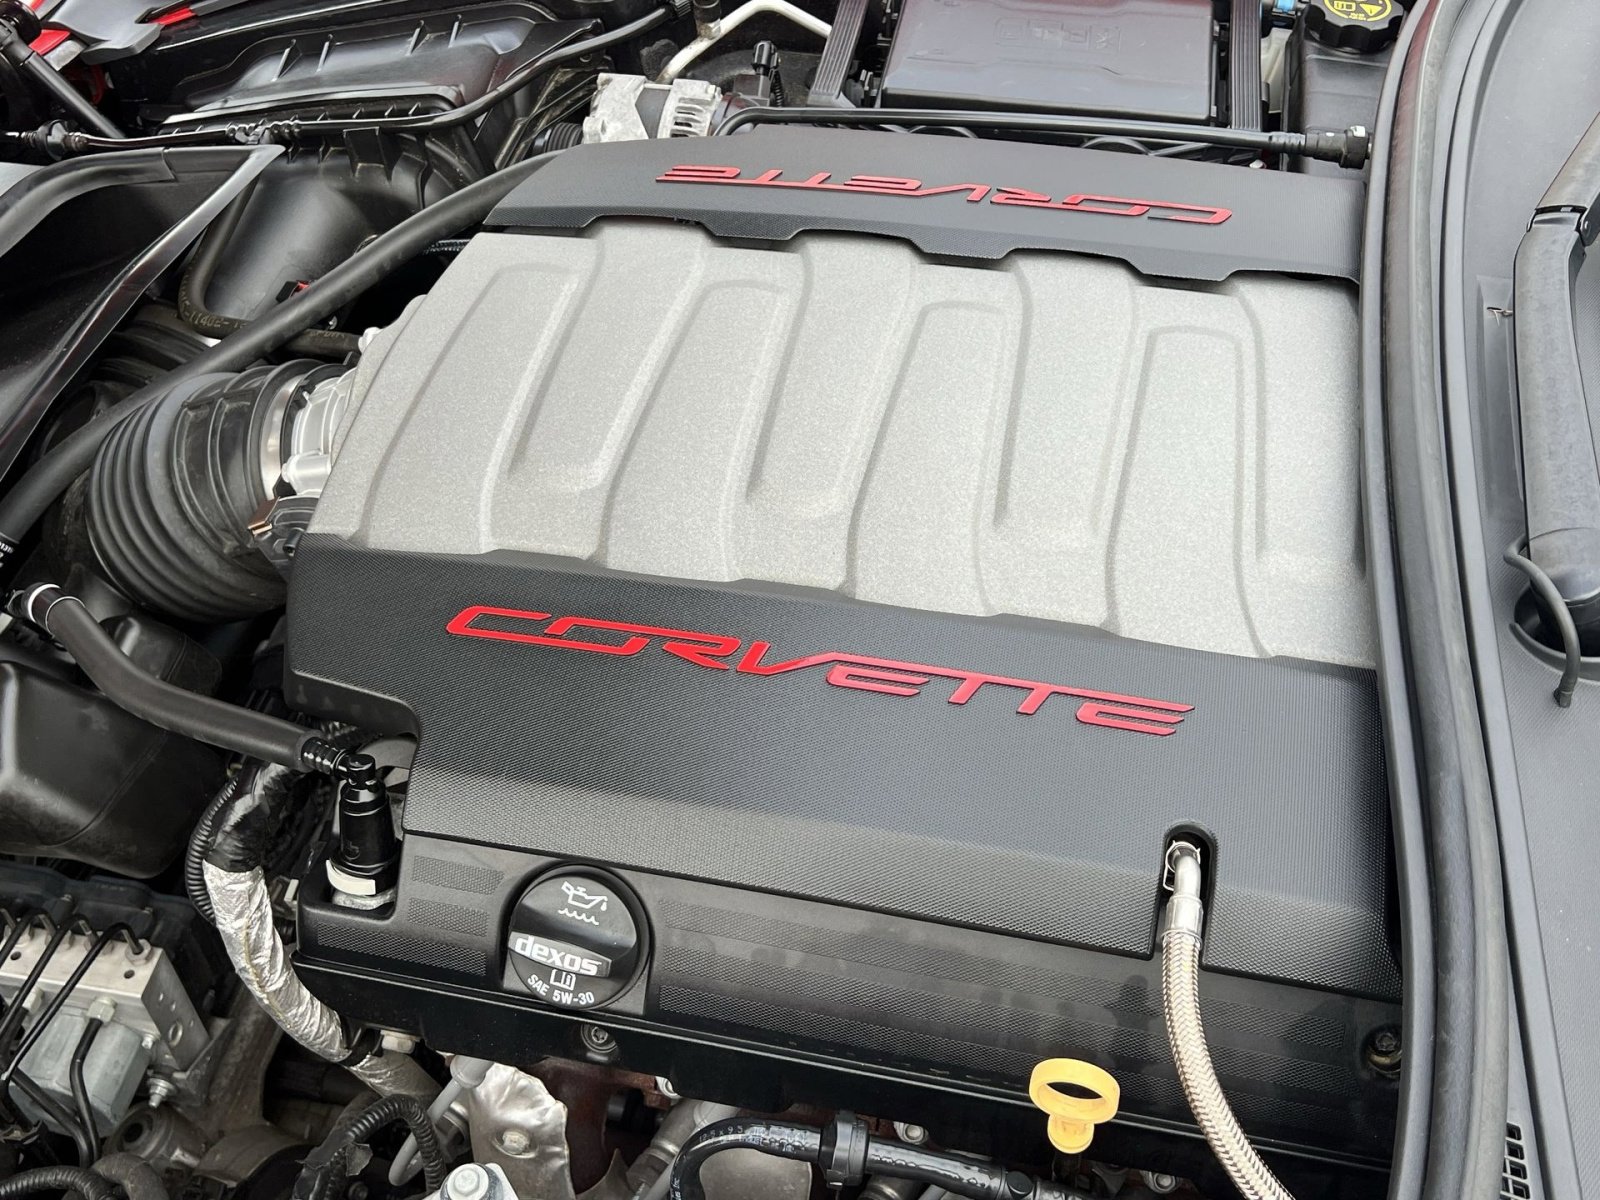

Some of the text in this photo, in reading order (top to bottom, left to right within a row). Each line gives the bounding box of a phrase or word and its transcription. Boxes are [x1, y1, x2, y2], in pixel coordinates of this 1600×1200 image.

[655, 164, 1233, 225] CORVETTE
[445, 604, 1194, 736] CORVETTE
[514, 934, 602, 976] dexos
[527, 974, 595, 1005] SAE 5W-30
